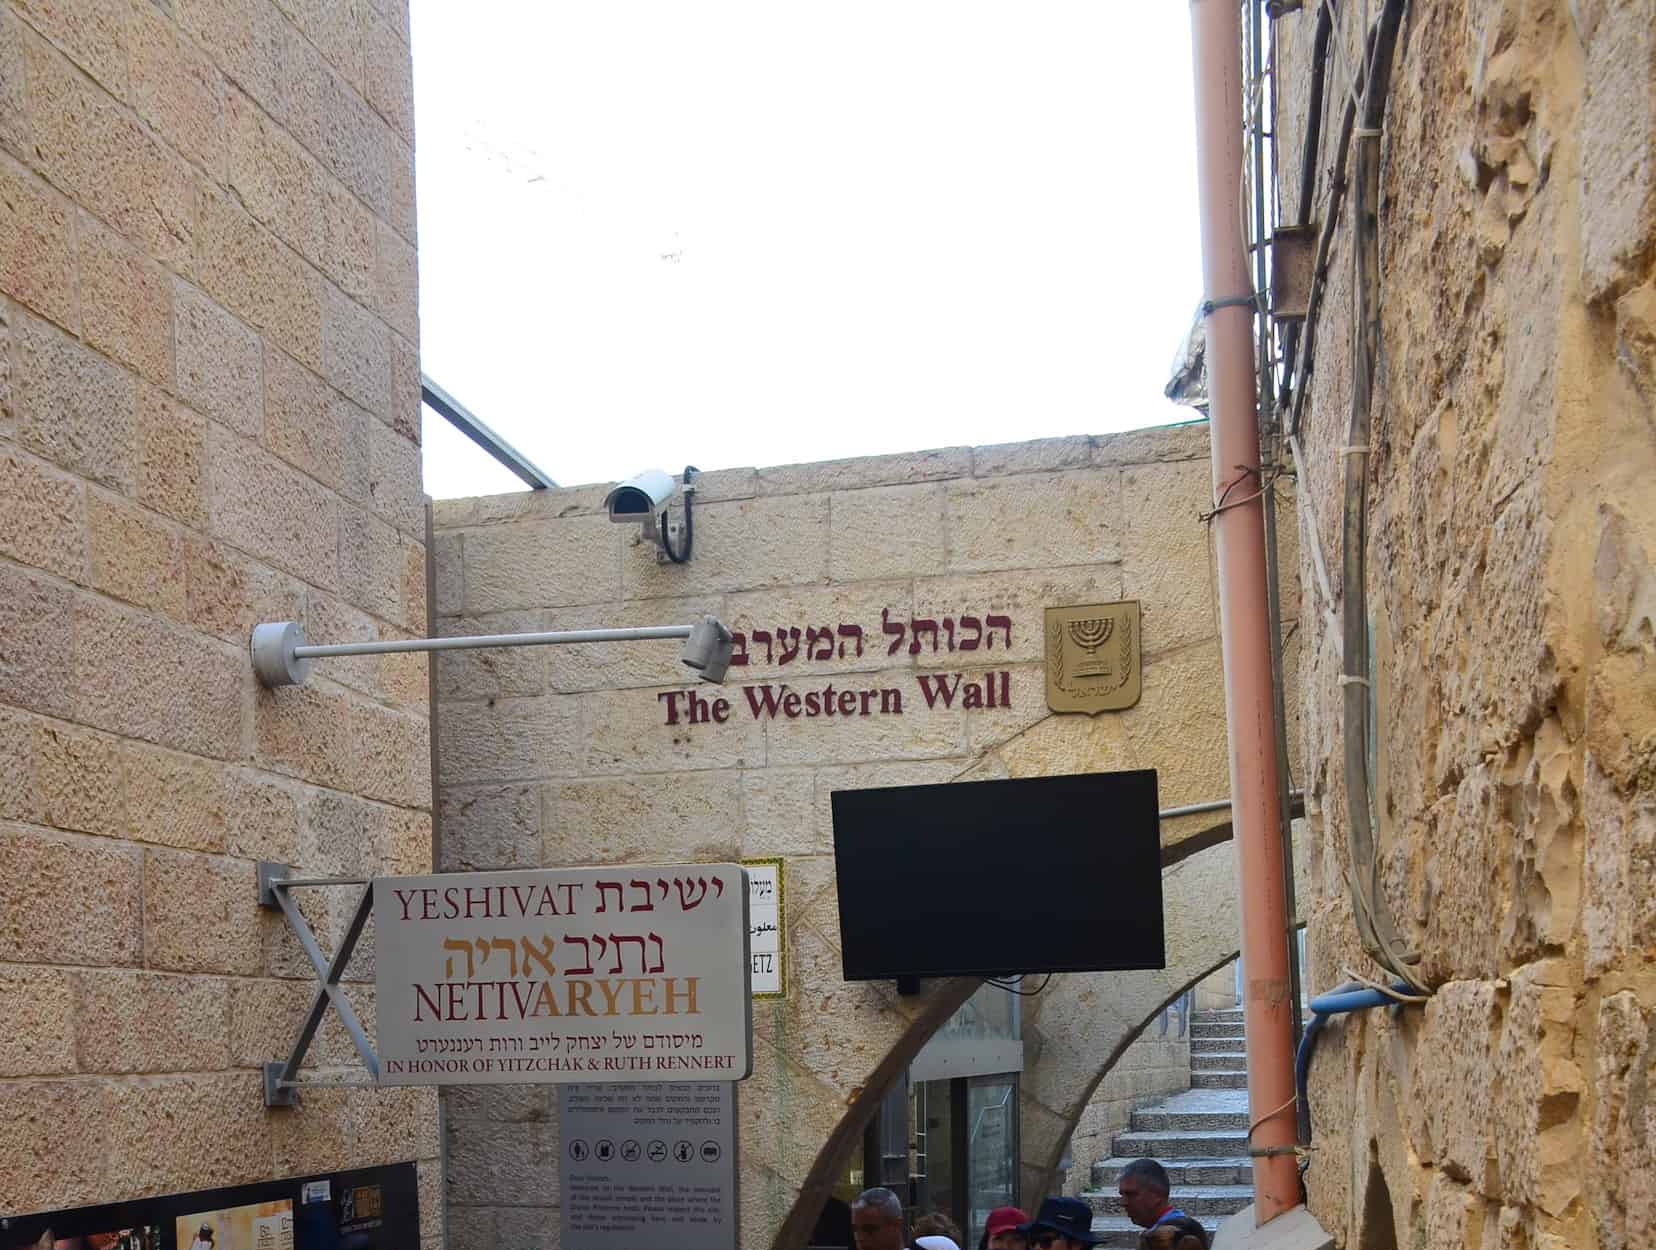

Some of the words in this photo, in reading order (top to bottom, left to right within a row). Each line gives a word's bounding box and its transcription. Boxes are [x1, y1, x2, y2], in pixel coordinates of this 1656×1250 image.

[881, 608, 1013, 657] הכותל
[730, 623, 863, 667] המערב
[657, 689, 730, 726] The
[743, 681, 903, 721] Western
[916, 670, 1012, 711] Wall
[393, 883, 584, 920] YESHIVAT
[595, 876, 725, 913] ישיבת
[752, 953, 773, 974] ETZ
[488, 1036, 524, 1052] ורות
[528, 1031, 562, 1052] לייב
[565, 1034, 608, 1054] יצחק
[612, 1029, 637, 1049] של
[642, 1033, 704, 1050] מיסודם
[386, 1059, 404, 1073] IN
[408, 1058, 469, 1073] HONOR
[472, 1058, 494, 1073] OF
[497, 1056, 583, 1073] YITZCHAK
[587, 1057, 600, 1071] &
[604, 1056, 652, 1071] RUTH
[656, 1055, 736, 1070] RENNERT
